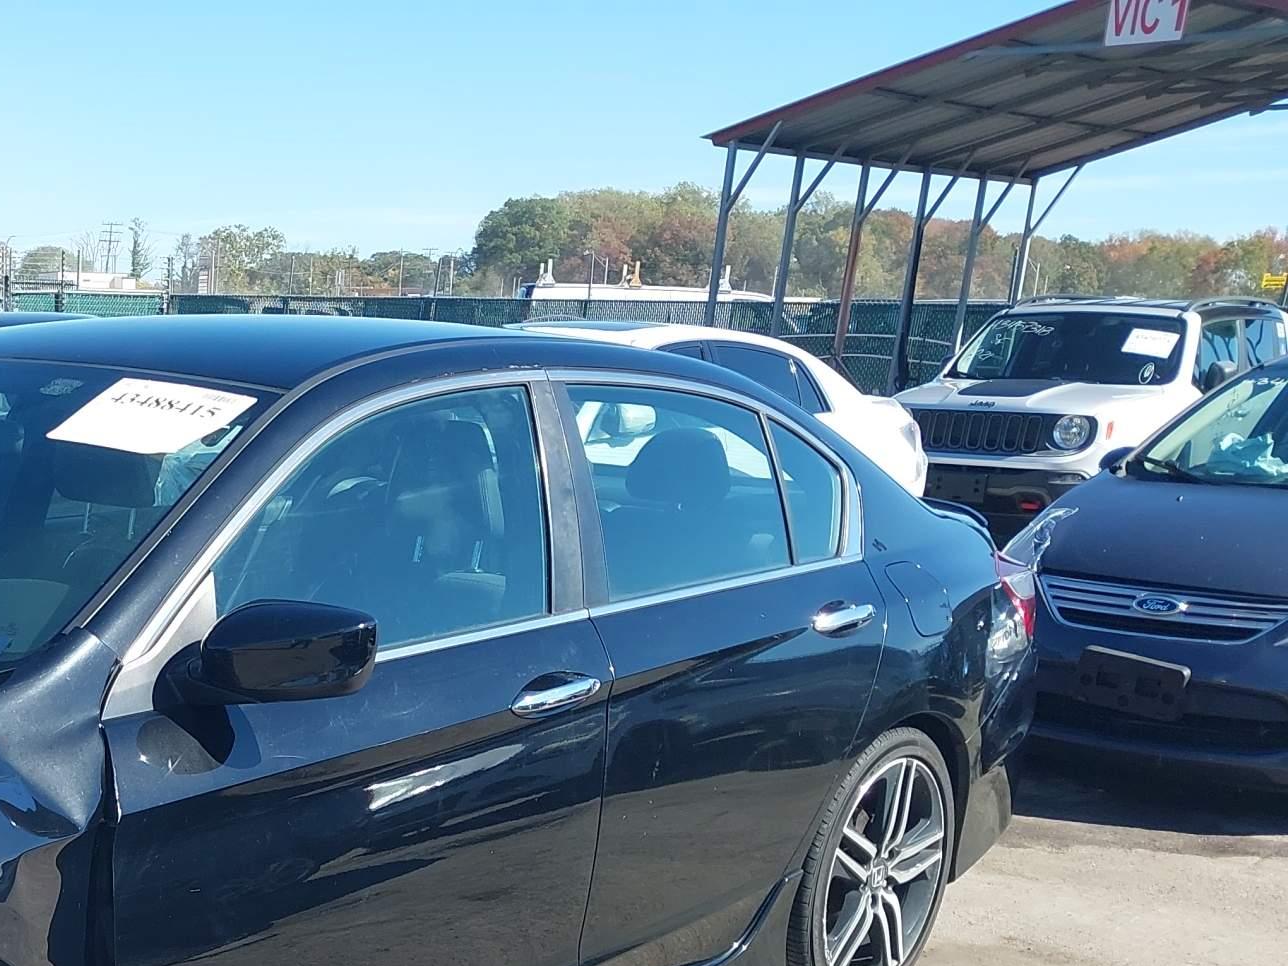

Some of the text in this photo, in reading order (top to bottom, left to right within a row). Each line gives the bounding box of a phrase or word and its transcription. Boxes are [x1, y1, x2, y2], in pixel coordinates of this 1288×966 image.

[1114, 0, 1188, 36] VIC 1
[111, 392, 222, 418] 43488415
[1142, 599, 1171, 611] Ford
